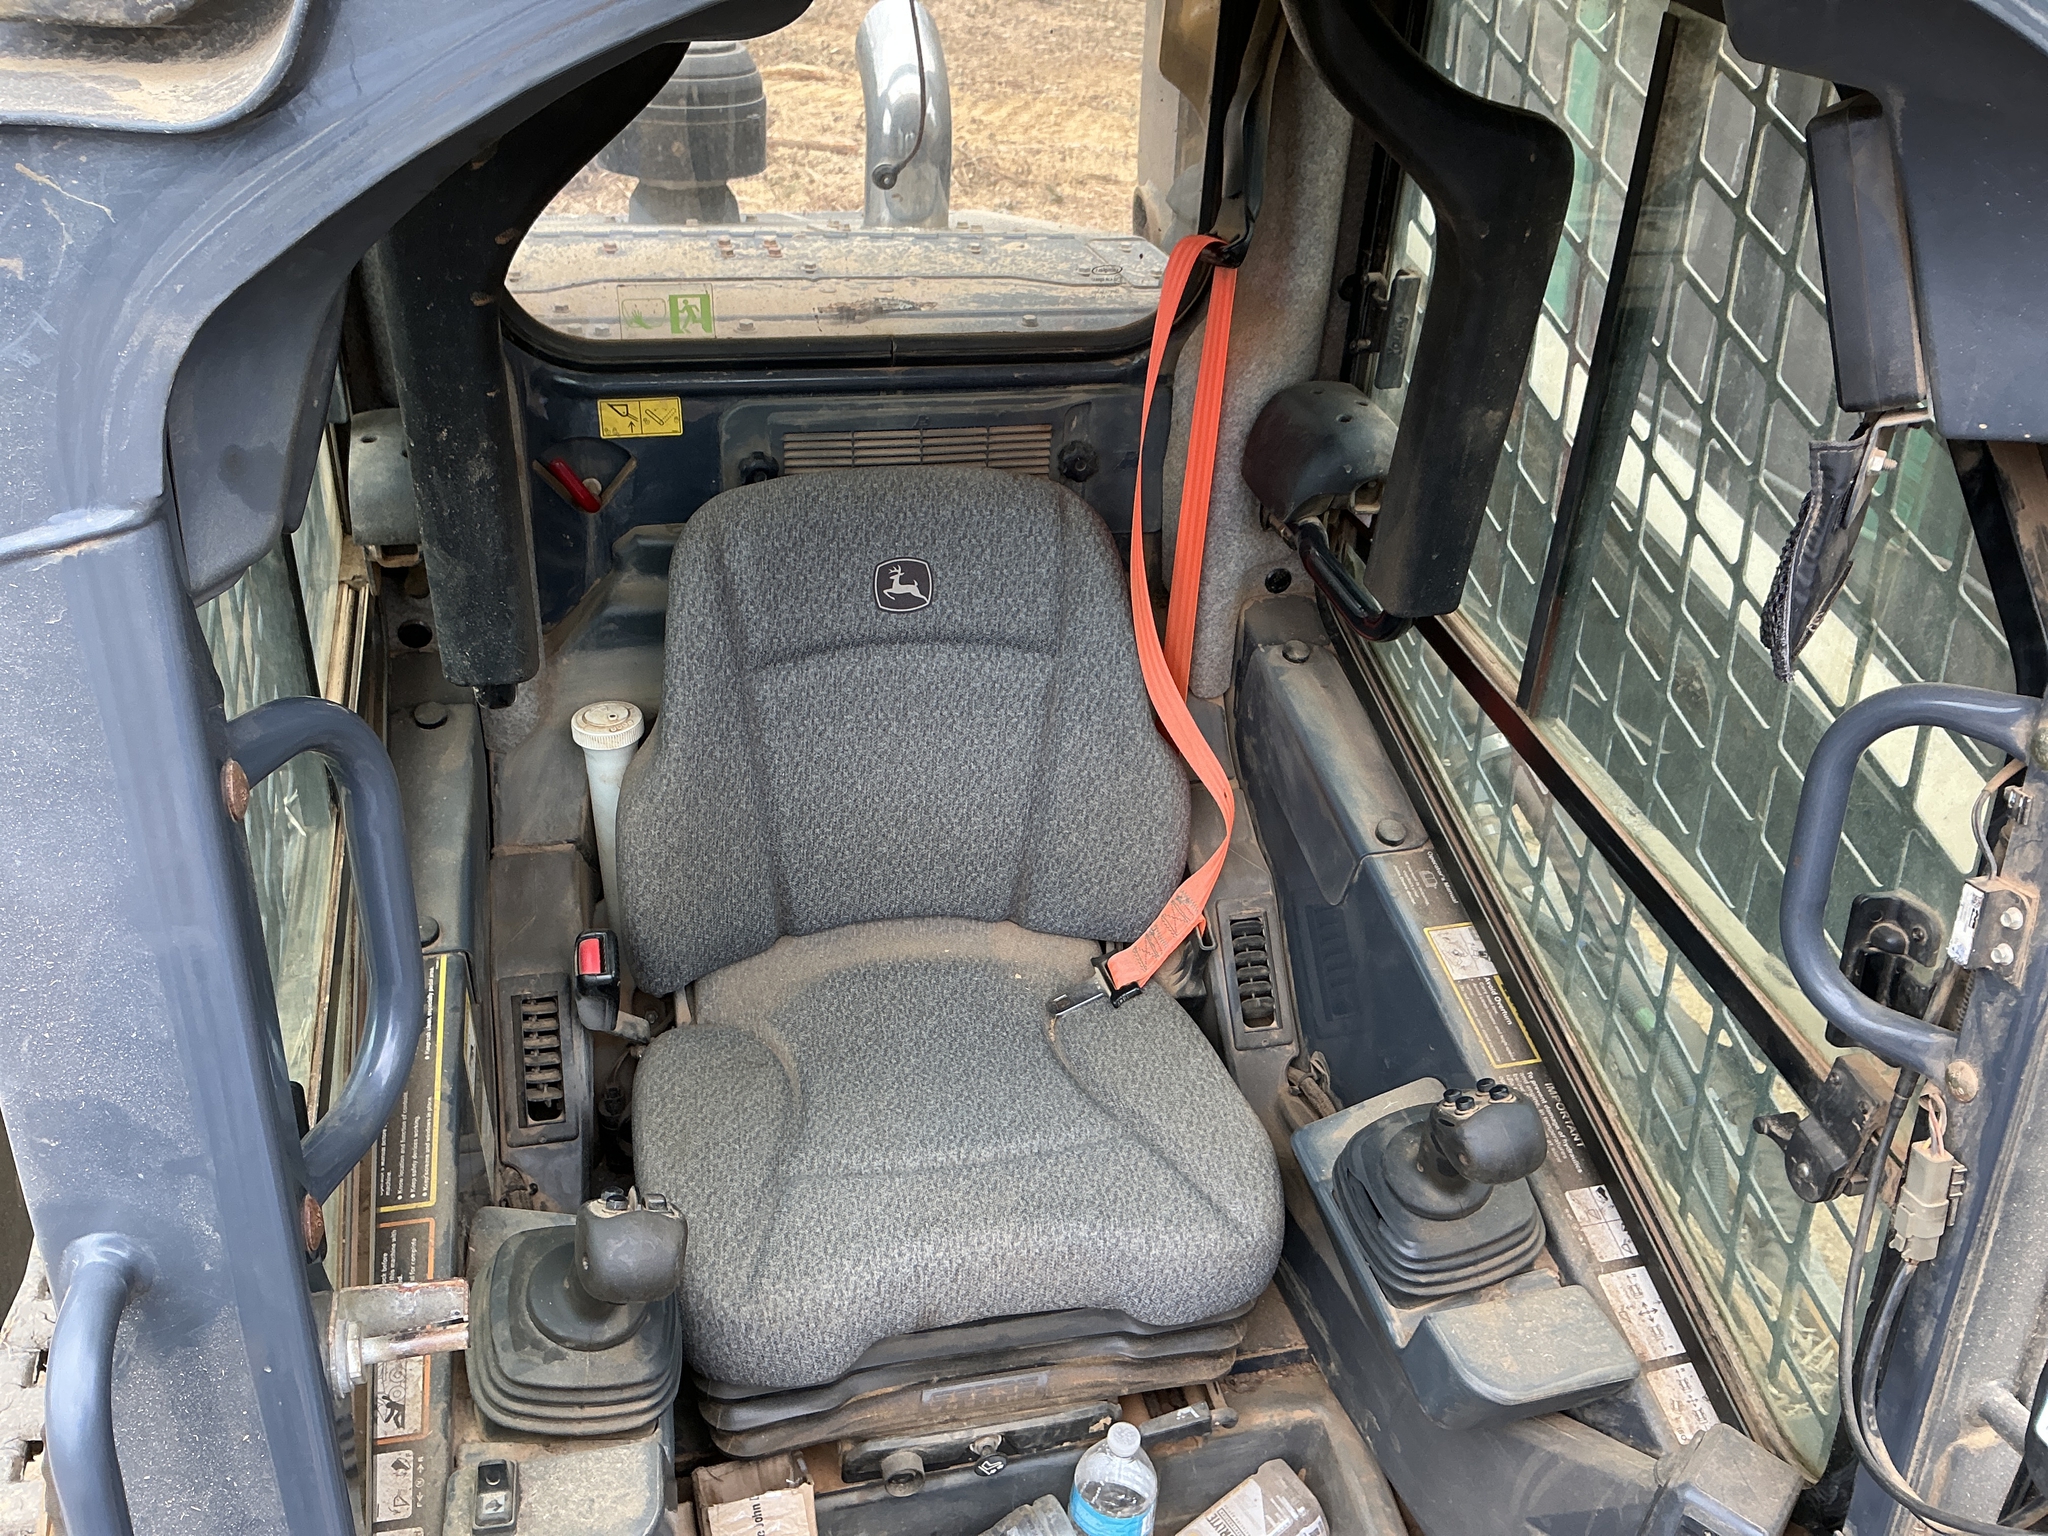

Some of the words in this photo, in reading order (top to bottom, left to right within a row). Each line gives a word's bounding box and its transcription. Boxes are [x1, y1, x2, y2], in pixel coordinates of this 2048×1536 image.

[1427, 850, 1447, 882] Operator's
[1443, 882, 1459, 905] Manual
[427, 978, 435, 992] pedal
[1483, 976, 1498, 996] Avoid
[1493, 995, 1513, 1025] Overturn
[1519, 1072, 1530, 1085] and
[1526, 1070, 1535, 1080] To
[1529, 1079, 1548, 1105] prevent
[1512, 1073, 1526, 1093] below
[1546, 1139, 1554, 1147] at
[1550, 1147, 1563, 1163] slow
[1538, 1108, 1546, 1117] in
[1542, 1104, 1562, 1131] damage
[1544, 1081, 1586, 1149] IMPORTANT
[413, 1115, 421, 1137] working.
[1541, 1116, 1569, 1160] temperatures
[1557, 1130, 1567, 1140] of
[1561, 1139, 1584, 1174] hydraulics
[752, 1504, 764, 1527] John
